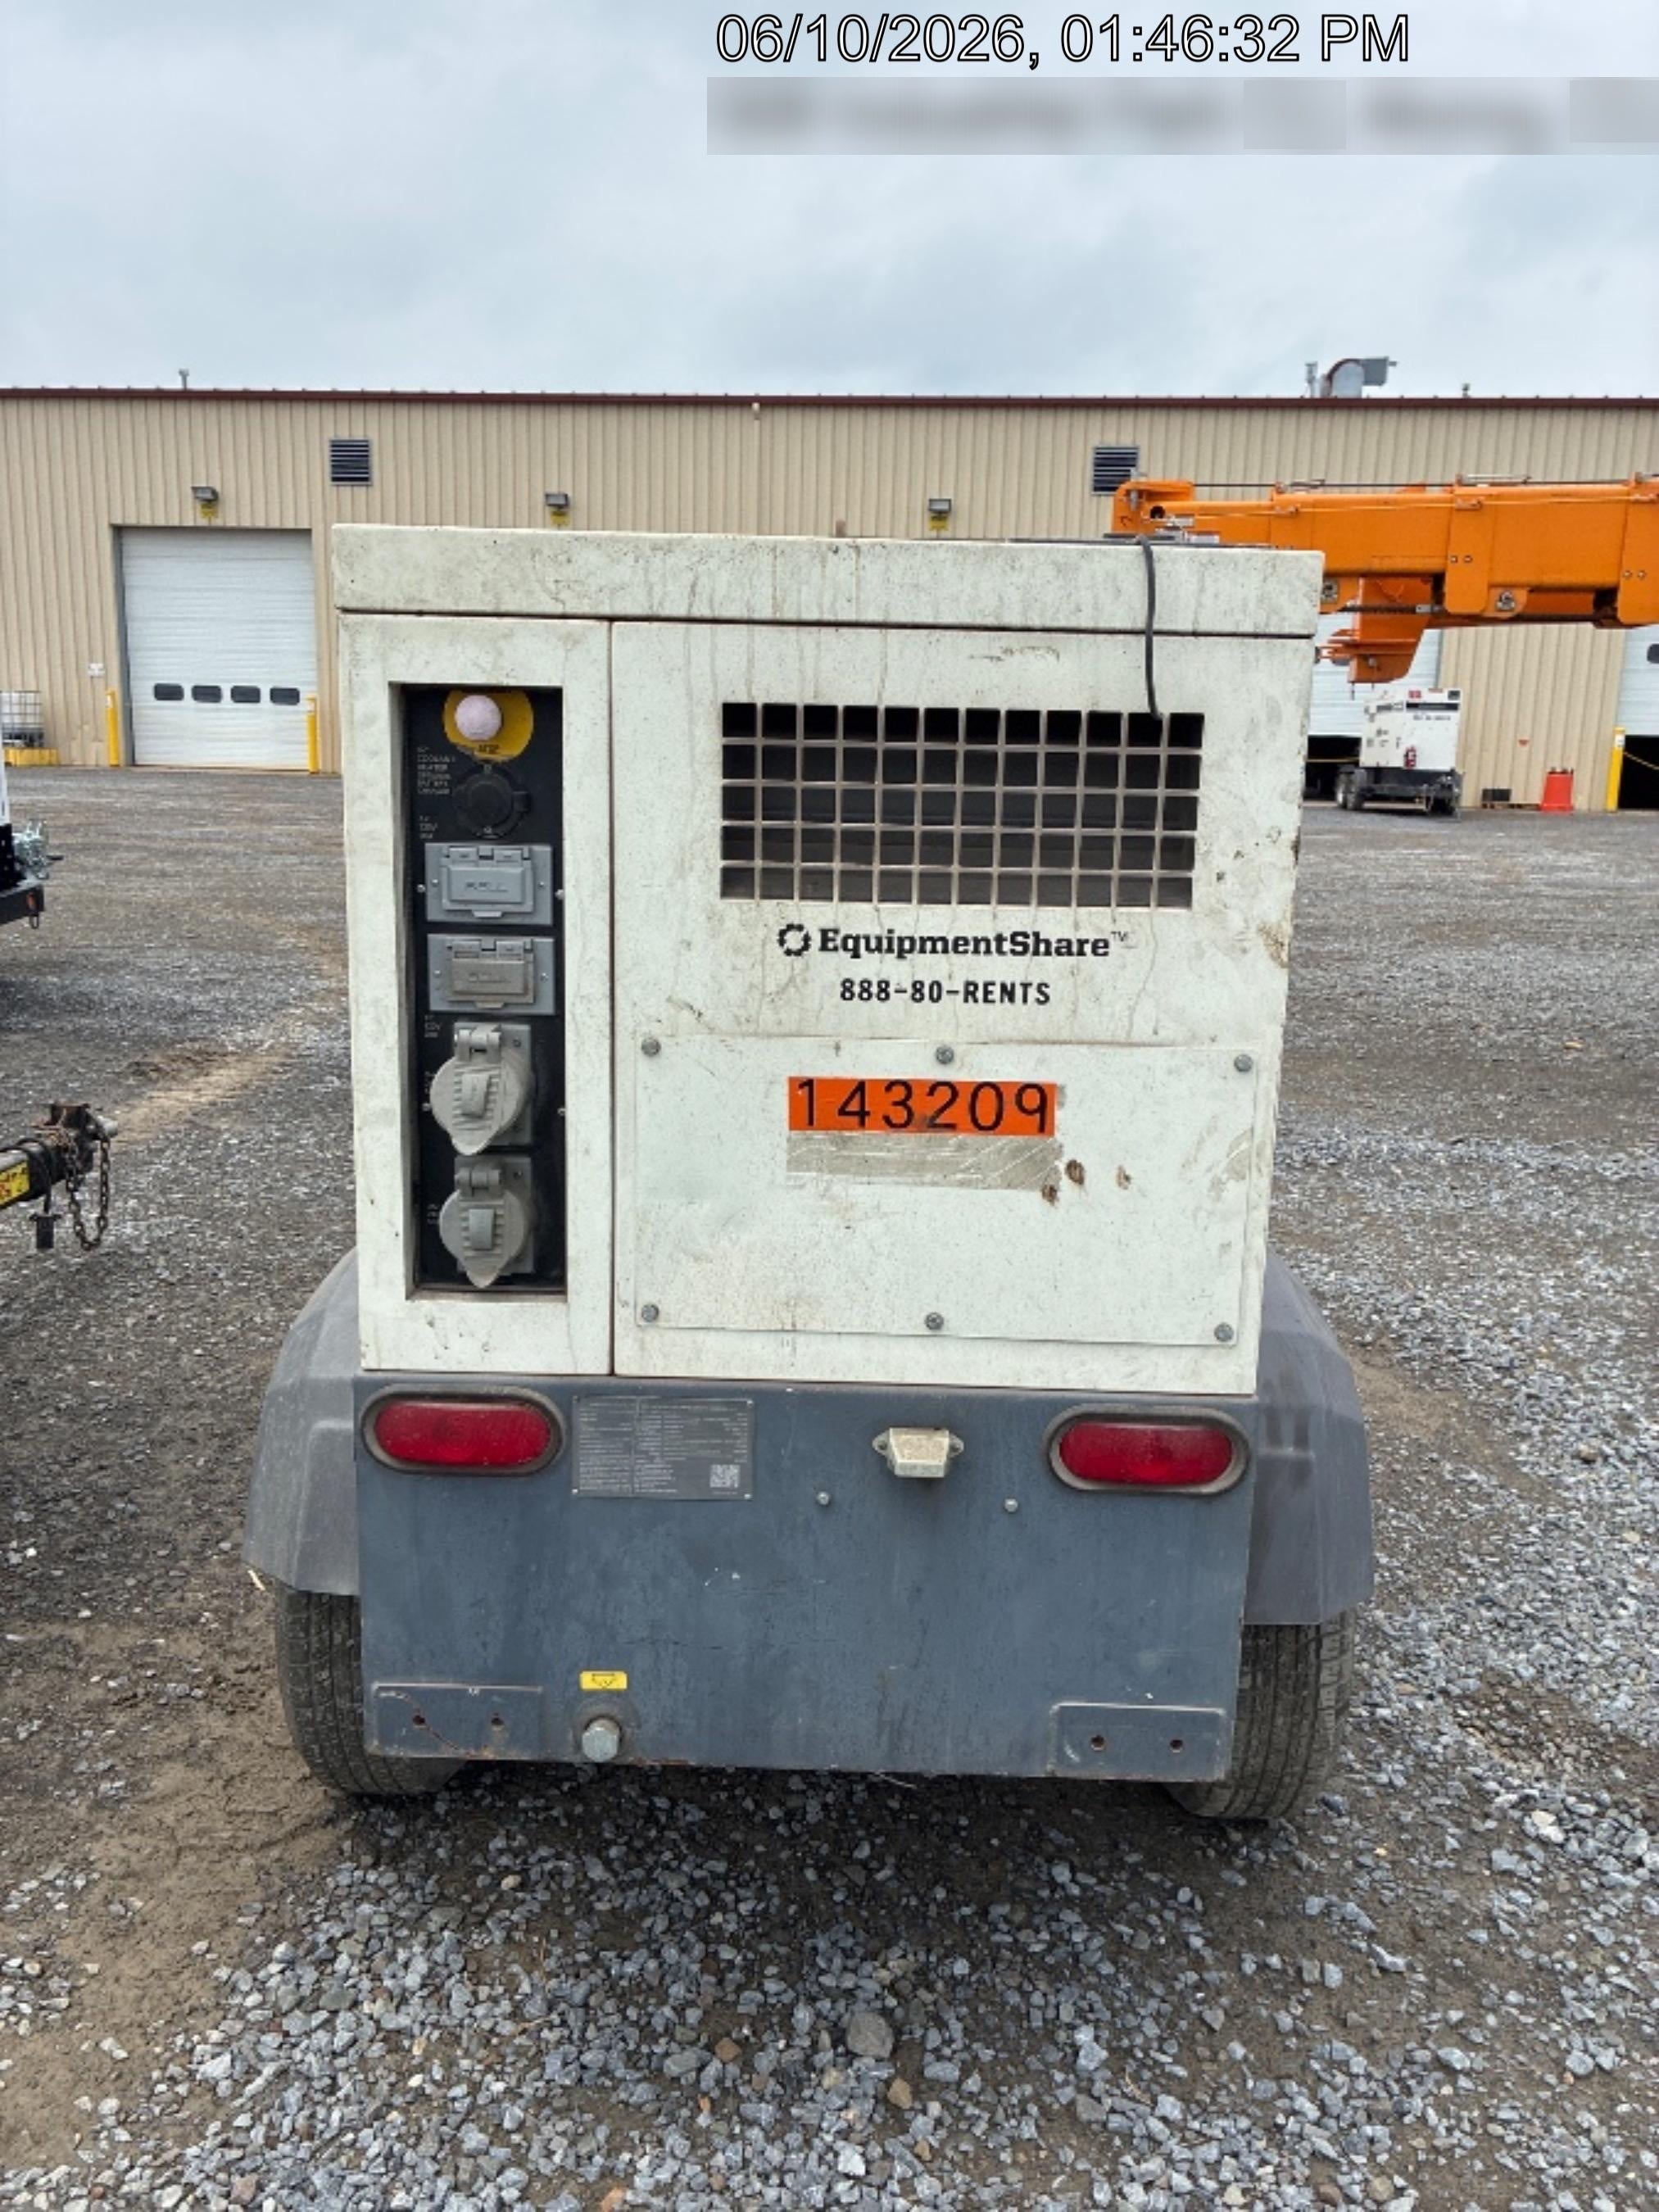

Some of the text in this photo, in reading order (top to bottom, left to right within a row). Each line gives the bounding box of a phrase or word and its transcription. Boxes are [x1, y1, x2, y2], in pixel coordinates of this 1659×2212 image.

[818, 928, 1109, 959] EquipmentShare
[840, 978, 1050, 1005] 888-80-RENTS
[797, 1079, 1049, 1134] 143209
